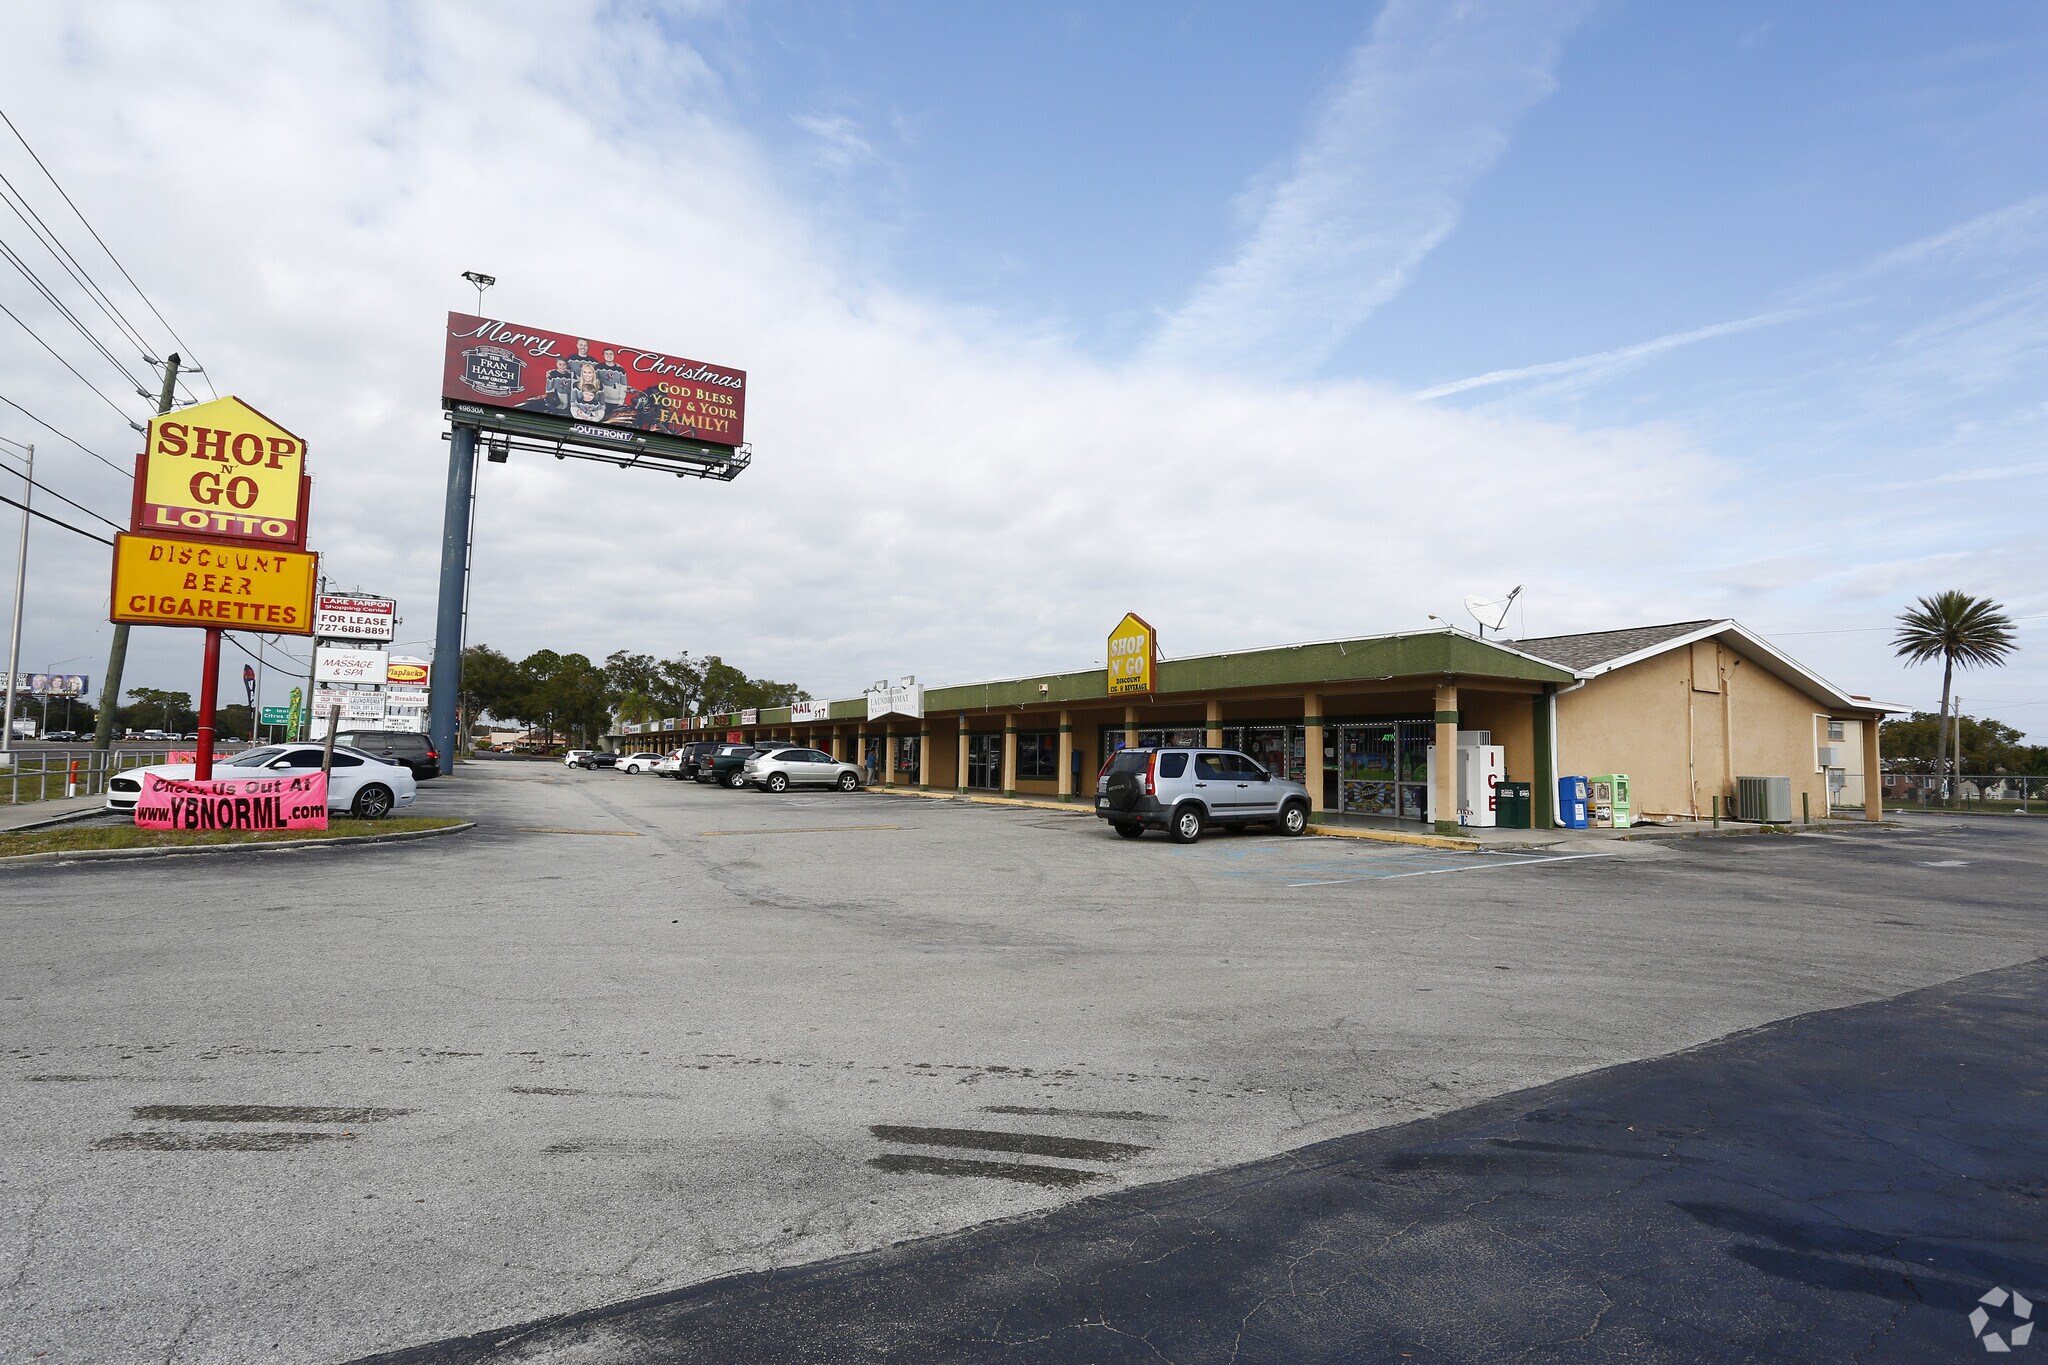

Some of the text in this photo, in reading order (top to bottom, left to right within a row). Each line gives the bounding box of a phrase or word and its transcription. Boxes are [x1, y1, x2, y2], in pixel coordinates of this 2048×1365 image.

[451, 320, 743, 389] Merry Christmas
[480, 358, 508, 370] FRAN
[472, 365, 515, 380] HAASCH
[658, 382, 733, 405] GOD BLESS
[458, 405, 484, 414] 49630A
[652, 393, 738, 420] YOU & YOUR
[660, 409, 729, 433] FAMILY!
[576, 426, 630, 440] OUTFRONT
[158, 422, 296, 470] SHOP
[189, 471, 259, 510] GO
[156, 507, 288, 537] LOTTO
[182, 572, 252, 595] BEER
[129, 595, 297, 624] CIGARETTES
[324, 604, 361, 612] Shopping
[353, 600, 390, 608] TARPON
[321, 614, 388, 626] FOR LEASE
[318, 624, 390, 636] 727-688-8891
[1110, 634, 1144, 658] SHOP
[322, 659, 374, 668] MASSAGE
[1126, 656, 1144, 676] GO
[333, 668, 364, 676] & SPA
[1116, 676, 1141, 684] DISCOUNT
[1125, 683, 1148, 692] BEVERAGE
[870, 694, 910, 706] LAUNDROMAT
[792, 703, 826, 718] NAIL $17
[212, 782, 236, 796] Us
[244, 779, 282, 794] Out
[289, 778, 312, 792] At
[1108, 784, 1125, 792] HONDA
[1488, 752, 1498, 812] ICE
[138, 796, 325, 829] www.YBNORML.com
